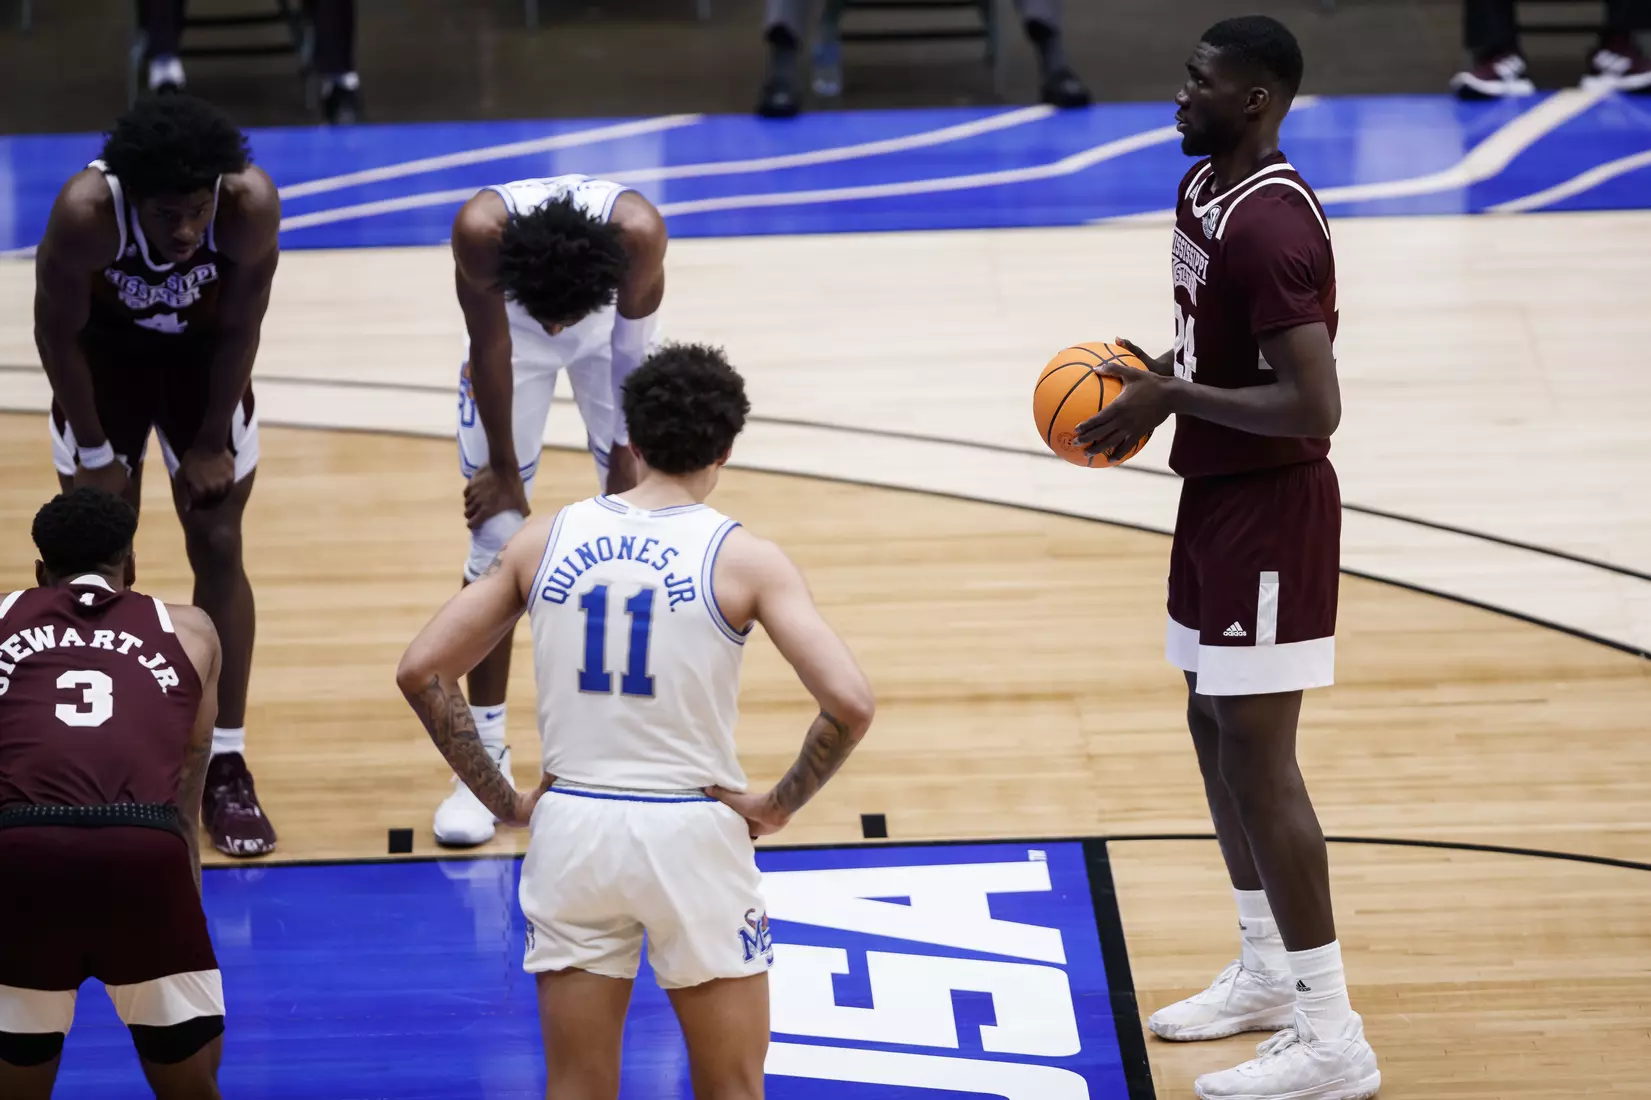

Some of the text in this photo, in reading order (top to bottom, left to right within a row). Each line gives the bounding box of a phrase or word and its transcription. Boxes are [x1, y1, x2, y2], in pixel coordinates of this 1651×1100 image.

[1172, 230, 1209, 280] ISSISSIPPI
[541, 535, 696, 613] QUINONES JR.
[577, 584, 656, 698] 11
[55, 669, 113, 727] 3
